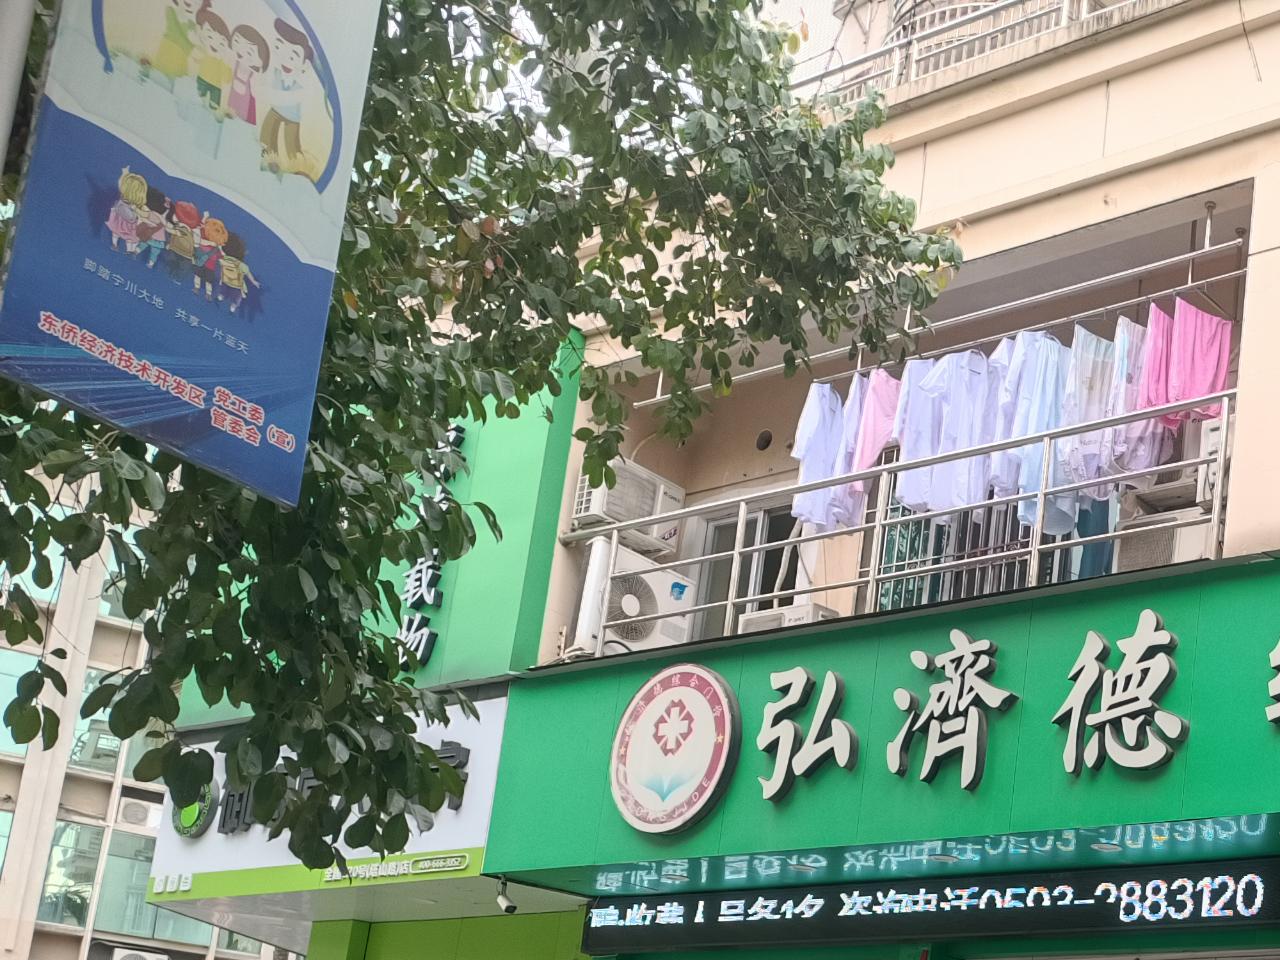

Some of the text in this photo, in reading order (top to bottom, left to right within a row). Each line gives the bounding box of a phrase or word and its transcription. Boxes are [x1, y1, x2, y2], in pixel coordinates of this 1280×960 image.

[38, 310, 206, 408] 东侨经济技术开发区
[212, 386, 264, 425] 党工委
[210, 408, 261, 446] 管委会
